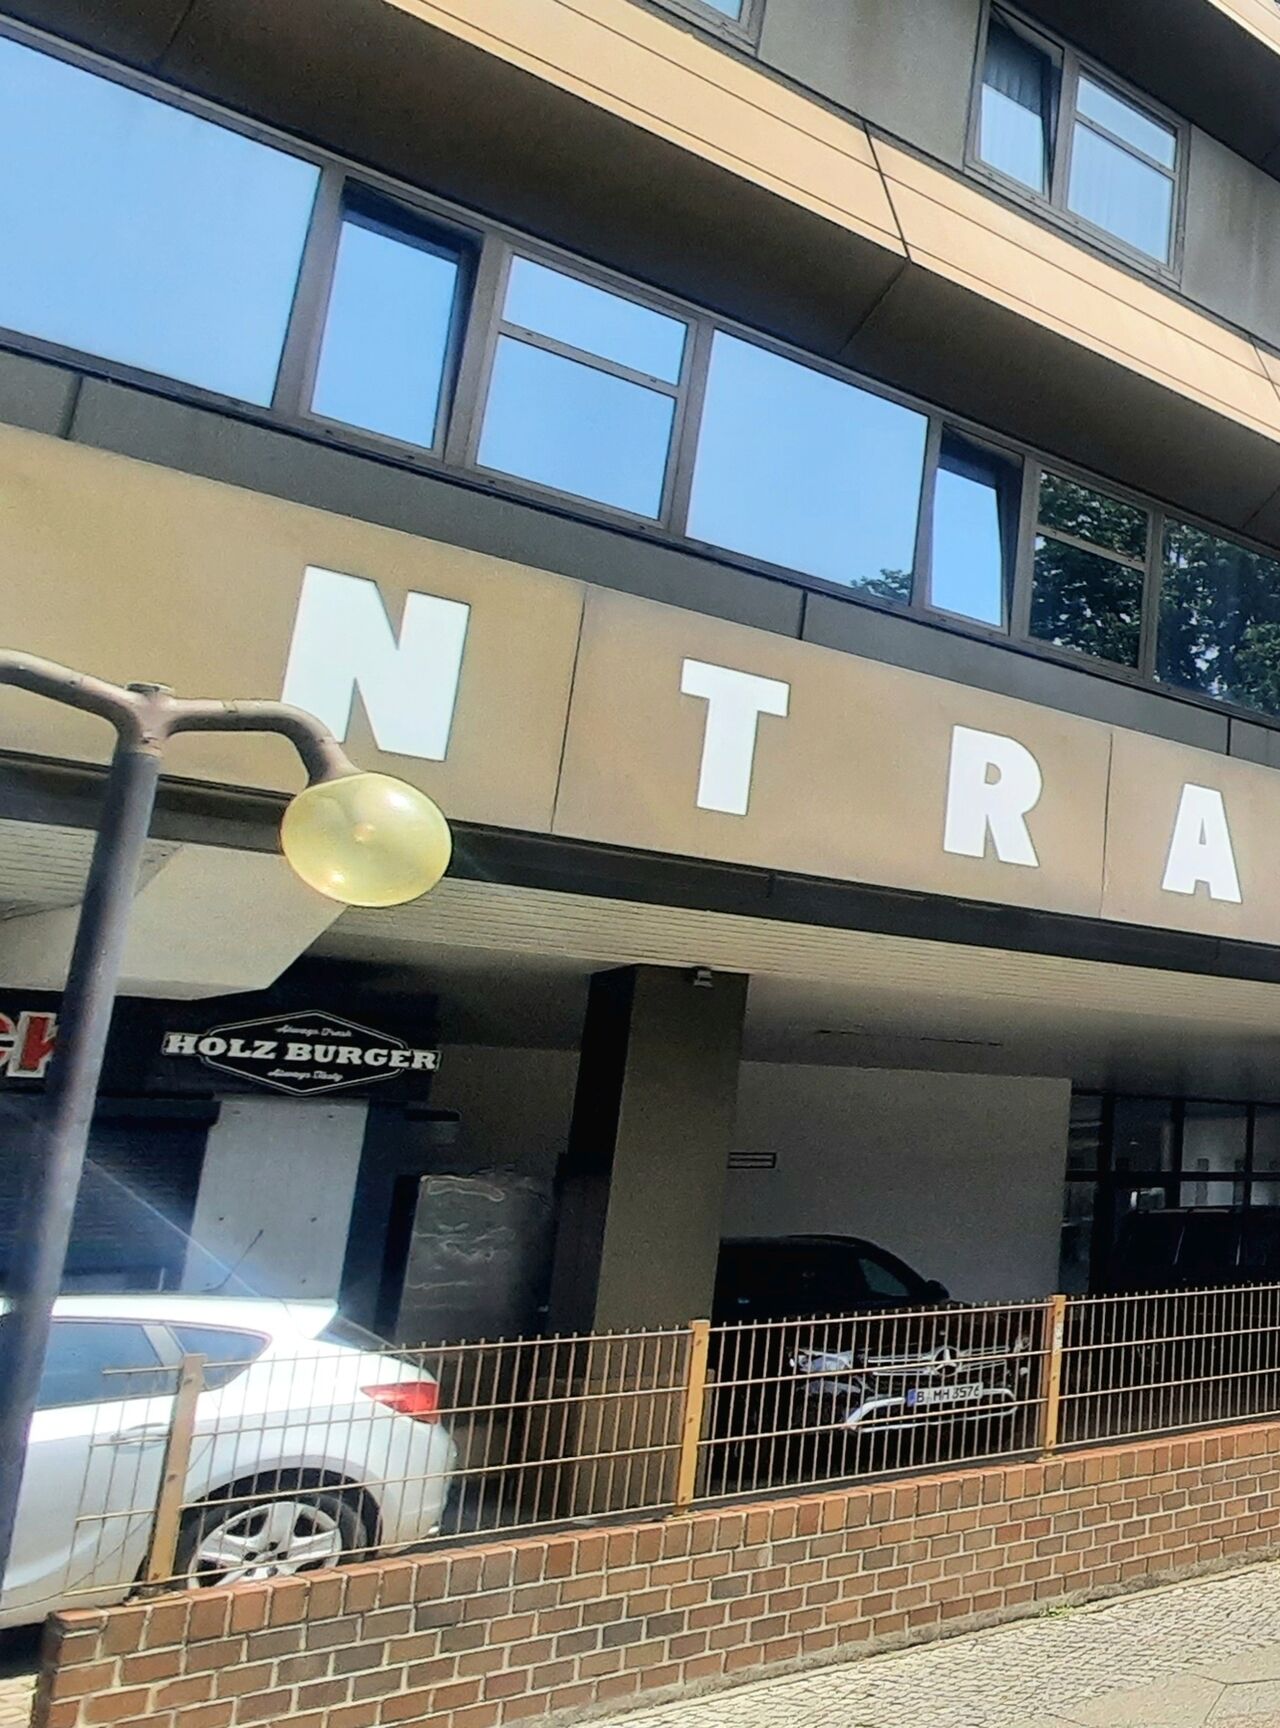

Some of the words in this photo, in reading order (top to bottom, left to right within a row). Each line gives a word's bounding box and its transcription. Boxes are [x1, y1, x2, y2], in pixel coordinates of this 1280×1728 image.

[165, 1033, 279, 1060] HOLZ
[283, 1041, 440, 1071] BURGER
[916, 1391, 925, 1403] B
